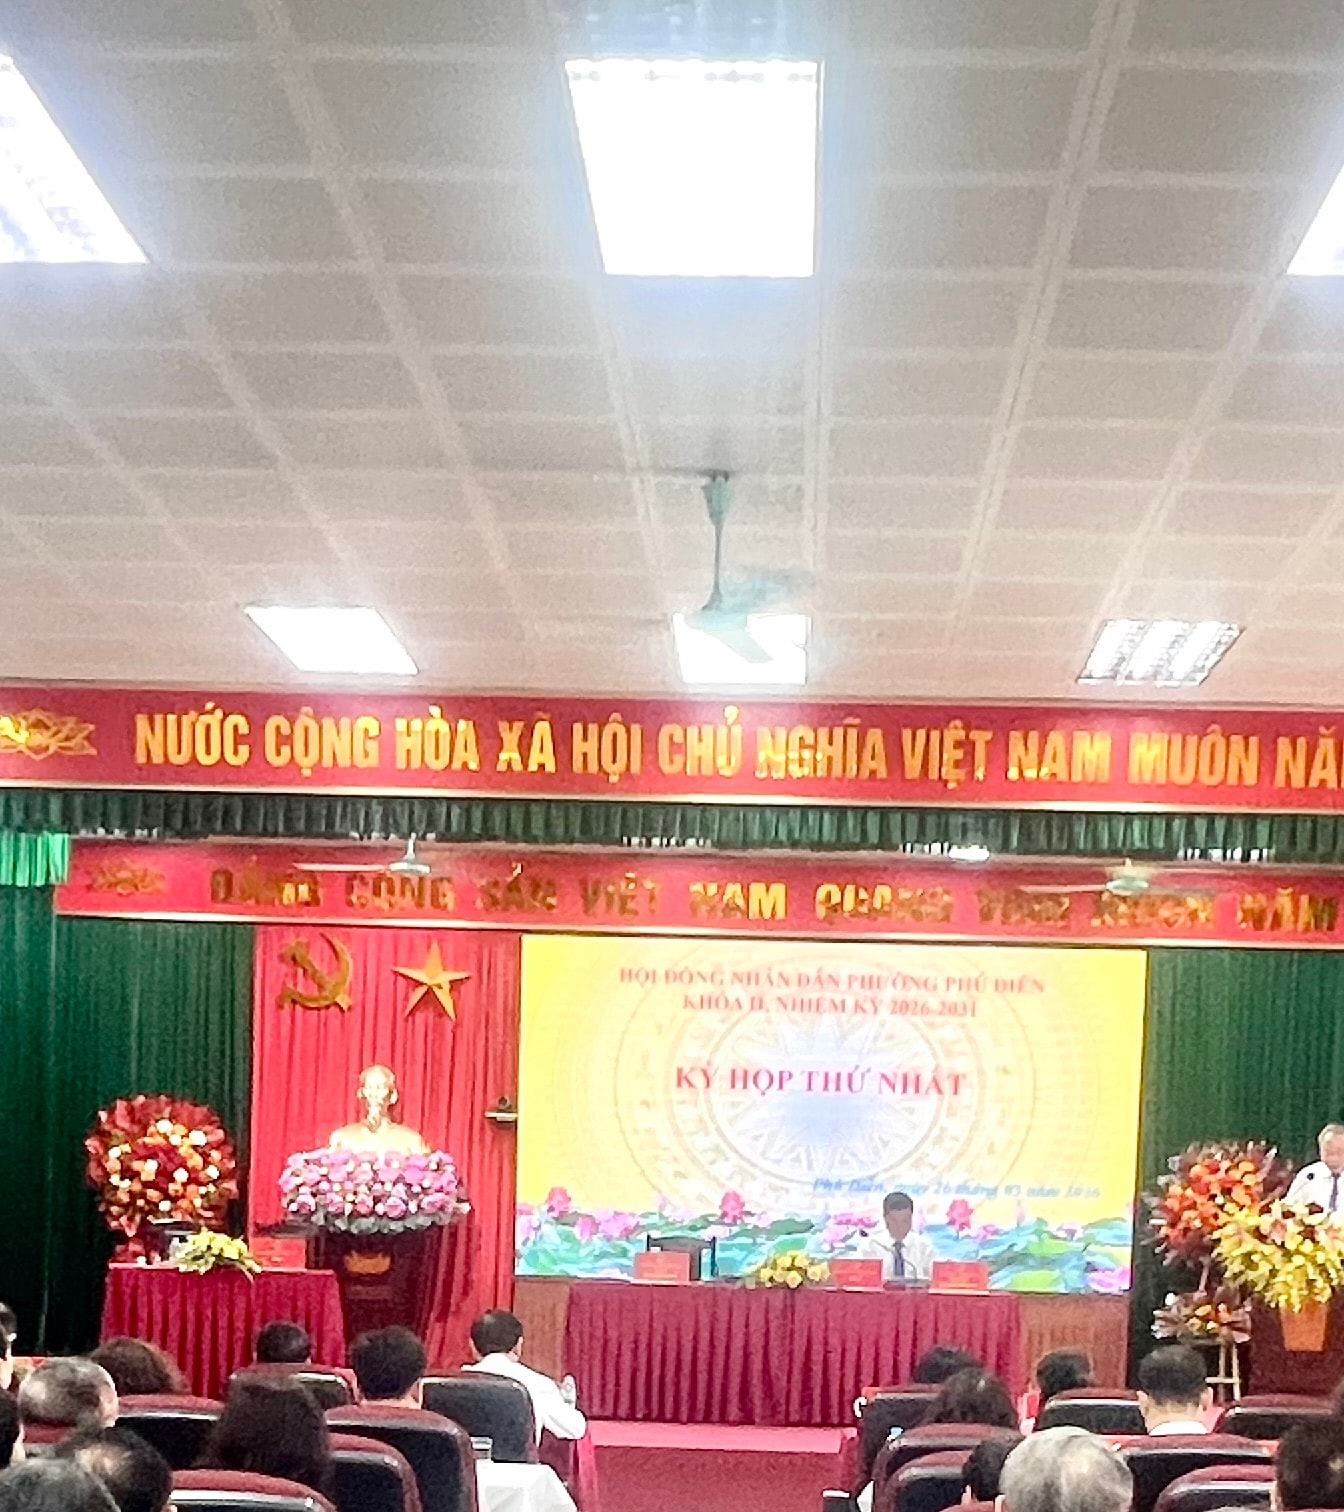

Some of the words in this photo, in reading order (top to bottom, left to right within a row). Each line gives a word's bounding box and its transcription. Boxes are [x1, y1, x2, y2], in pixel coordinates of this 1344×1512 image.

[135, 701, 250, 767] NƯỚC
[264, 706, 381, 777] CỘNG
[394, 704, 480, 772] HÒA
[497, 711, 556, 773] XÃ
[572, 712, 642, 783] HỘI
[658, 705, 743, 777] CHỦ
[755, 717, 886, 781] NGHĨA
[902, 719, 993, 789] VIỆT
[1007, 729, 1112, 783] NAM
[1128, 725, 1258, 787] MUÔN
[620, 967, 656, 988] HỘI
[729, 1067, 794, 1095] HỌP
[802, 1064, 871, 1093] THỨ
